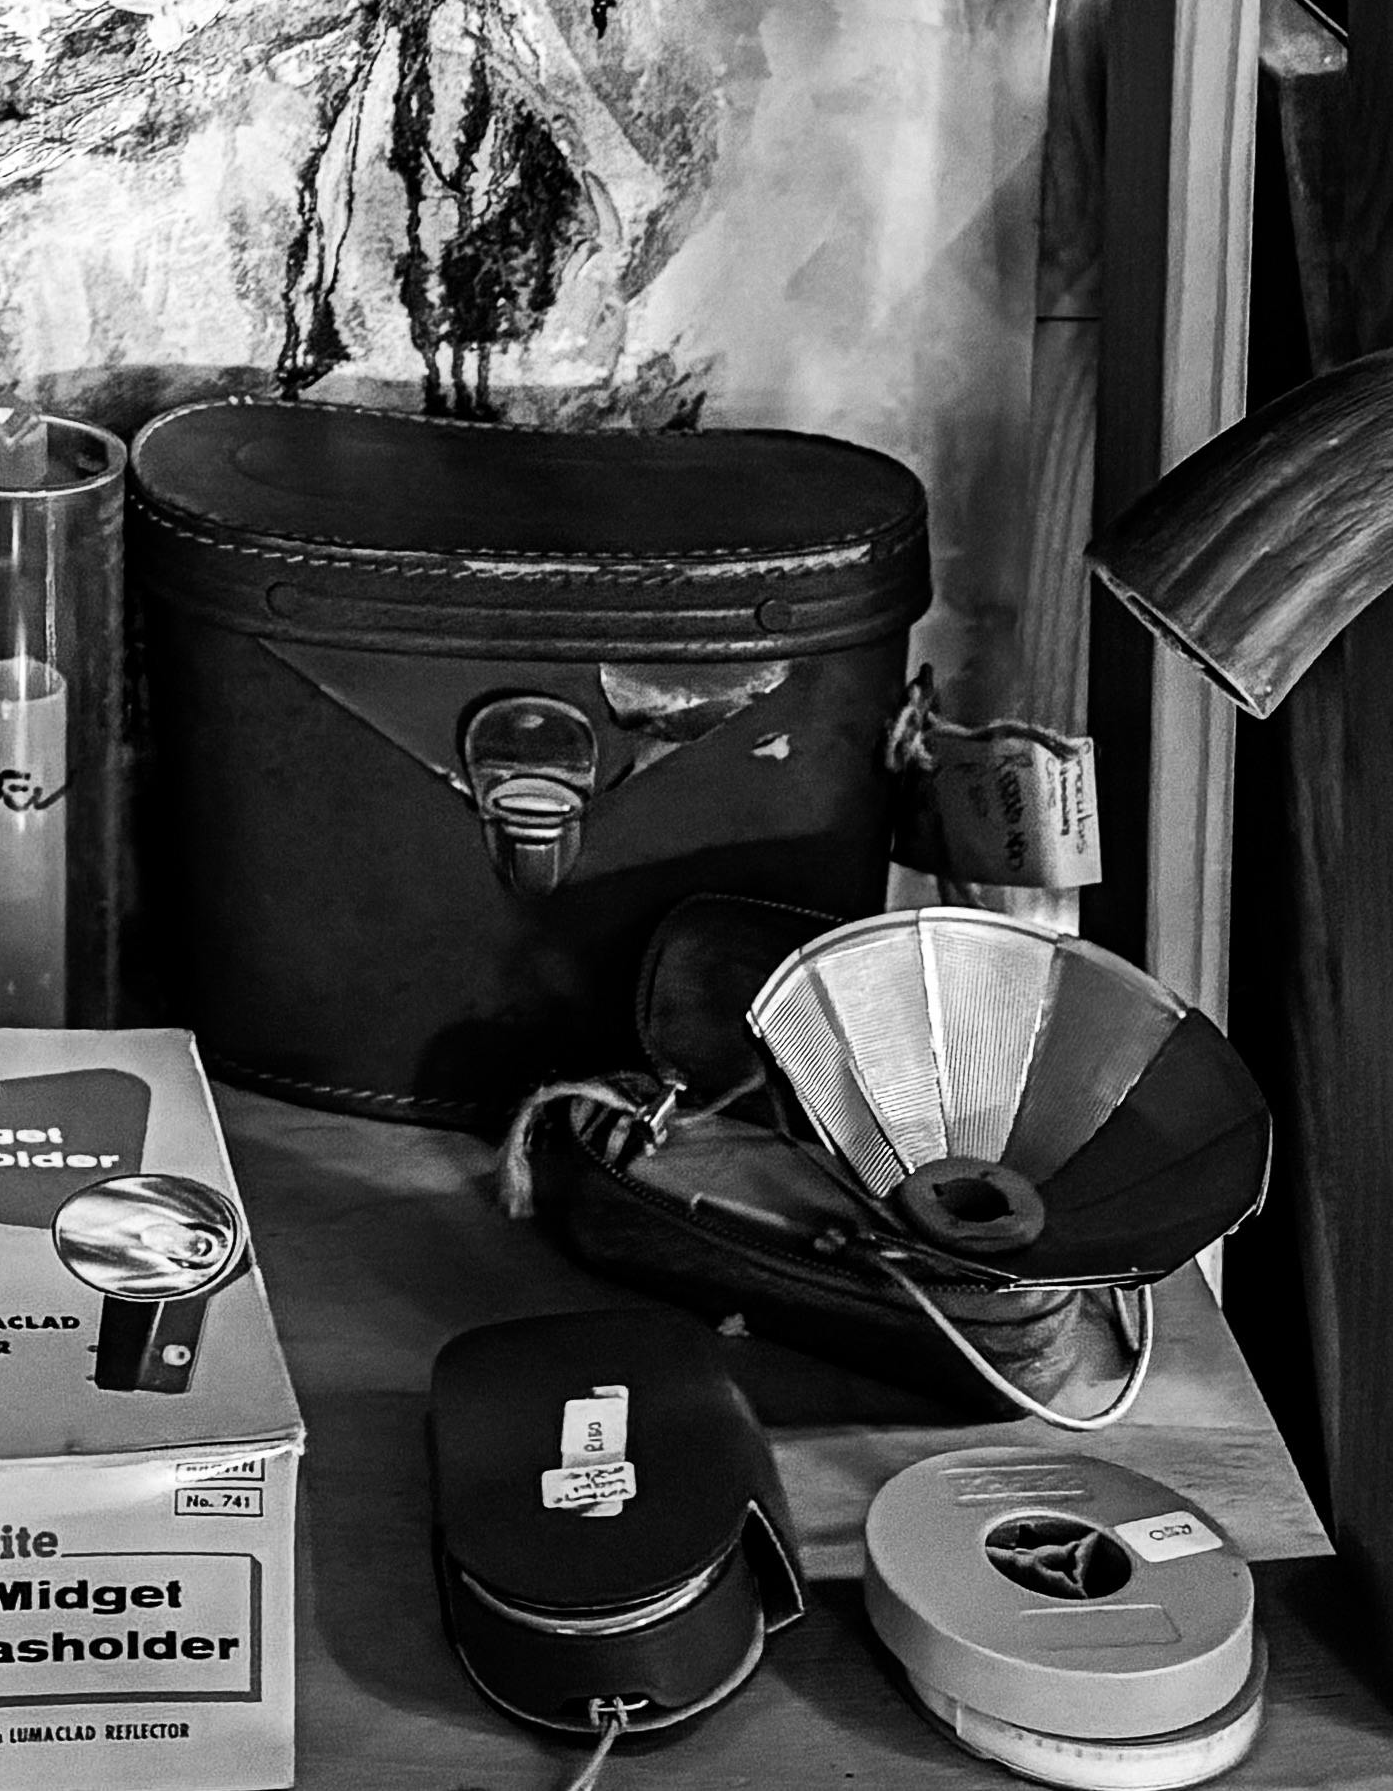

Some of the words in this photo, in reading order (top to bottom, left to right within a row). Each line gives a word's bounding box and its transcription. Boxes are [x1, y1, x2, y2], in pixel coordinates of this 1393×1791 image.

[186, 1494, 214, 1509] No.
[220, 1493, 251, 1509] 741
[9, 1723, 97, 1745] LUMACLAD
[104, 1721, 190, 1742] REFLECTOR
